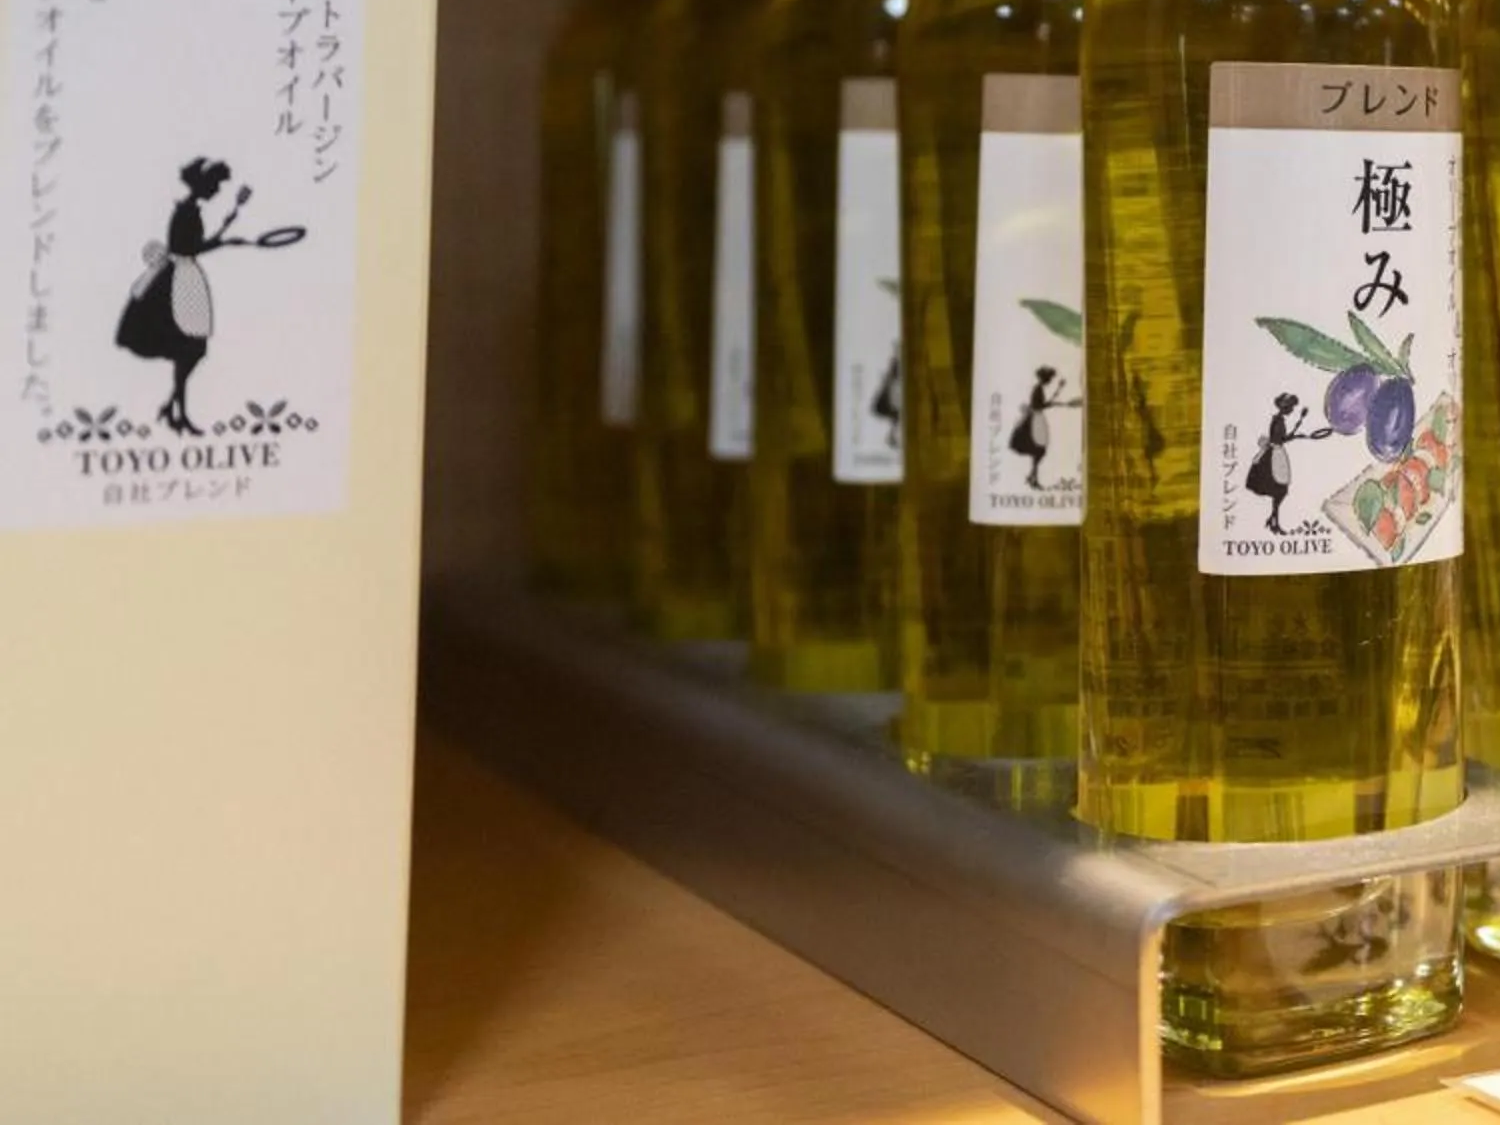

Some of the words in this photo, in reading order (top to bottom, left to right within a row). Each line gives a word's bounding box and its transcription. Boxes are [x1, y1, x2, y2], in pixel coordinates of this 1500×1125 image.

[1322, 81, 1438, 117] ブレンド
[1352, 159, 1412, 318] 極み
[73, 445, 170, 476] TOYO
[181, 442, 281, 471] OLIVE
[102, 477, 252, 506] 自社ブレンド
[1222, 424, 1238, 530] 自社ブレンド
[1223, 539, 1275, 556] TOYO
[1280, 537, 1332, 555] OLIVE
